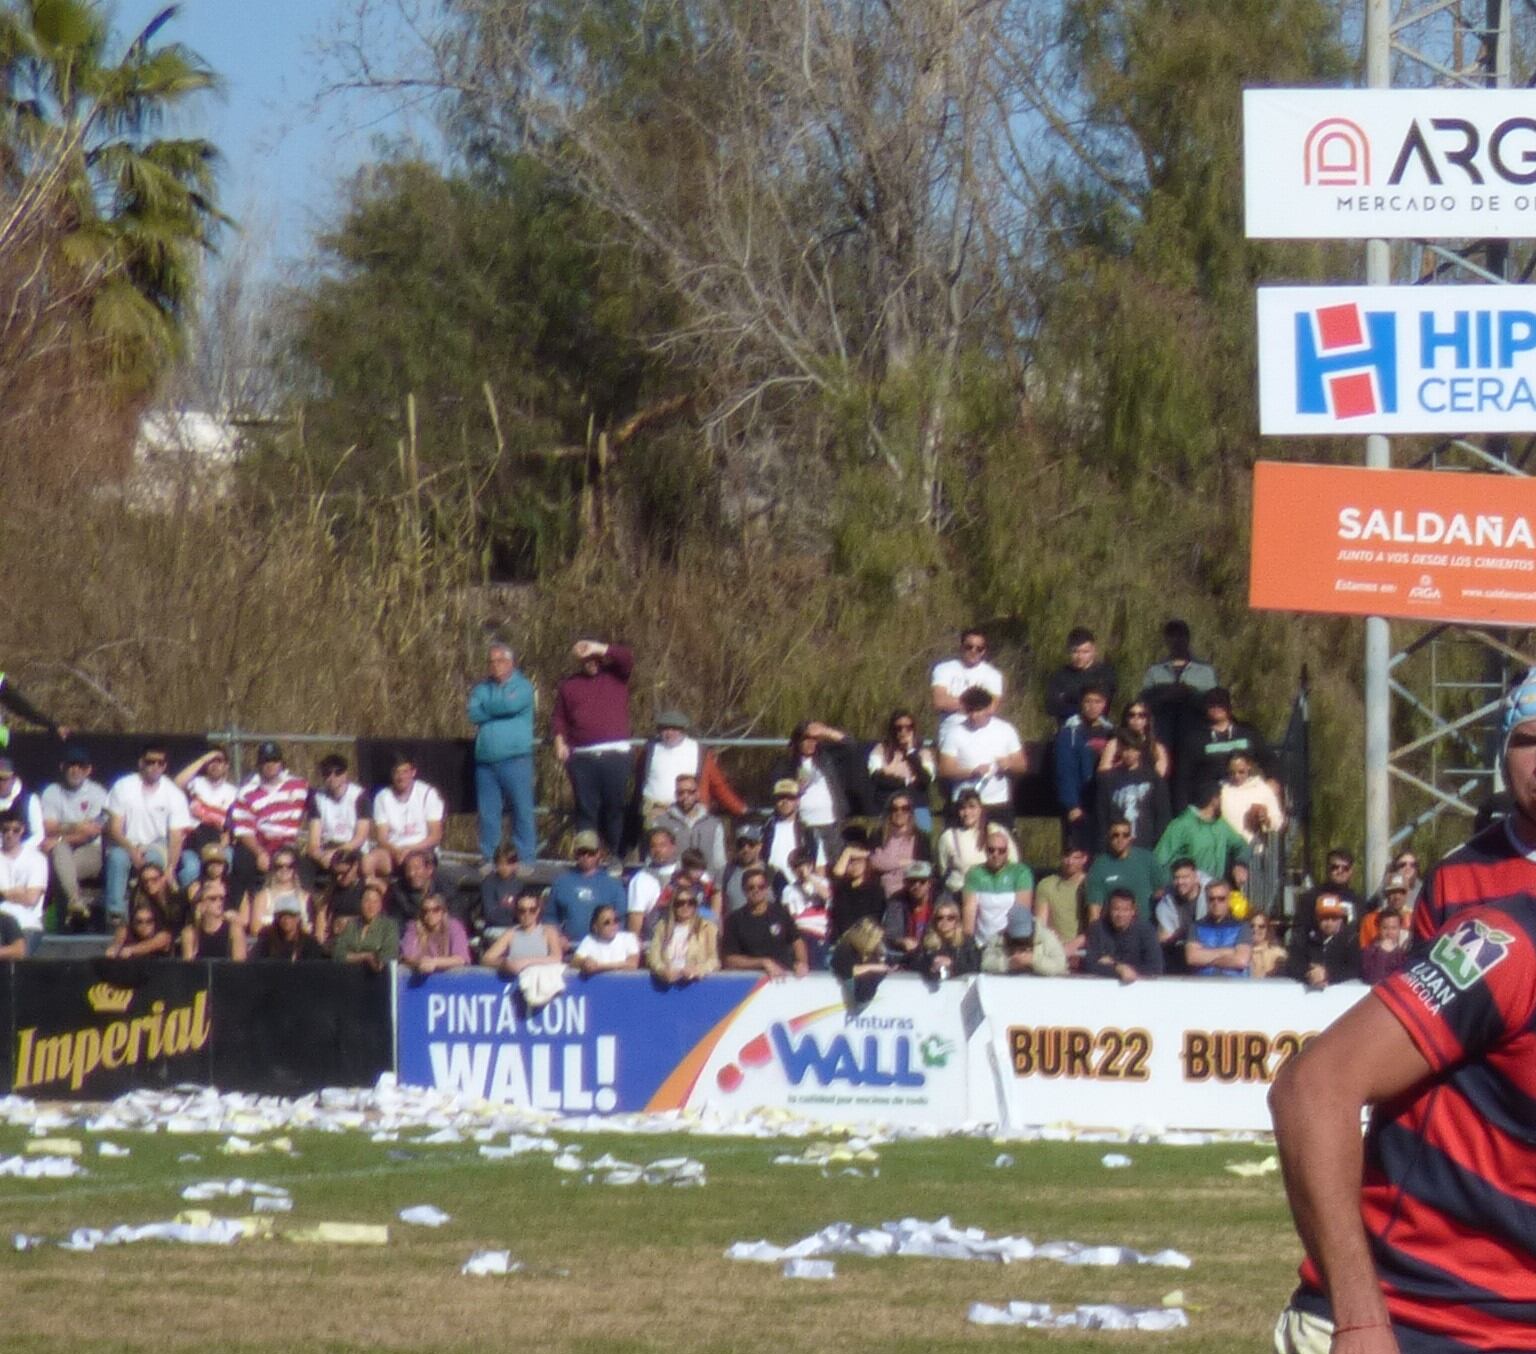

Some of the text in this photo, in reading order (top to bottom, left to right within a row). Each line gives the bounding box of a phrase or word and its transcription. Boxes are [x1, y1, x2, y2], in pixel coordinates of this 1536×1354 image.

[1337, 196, 1456, 212] MERCADO
[1472, 196, 1500, 211] DE
[1335, 579, 1378, 593] Estamos
[1337, 549, 1535, 571] JUNTO A VOS DESDE LOS CIMIENTOS
[428, 982, 517, 1035] PINTÁ
[844, 1016, 914, 1030] Pinturas
[13, 990, 211, 1091] Imperial
[771, 1021, 926, 1087] WALL
[1009, 1026, 1153, 1080] BUR22
[429, 1035, 617, 1112] WALL!
